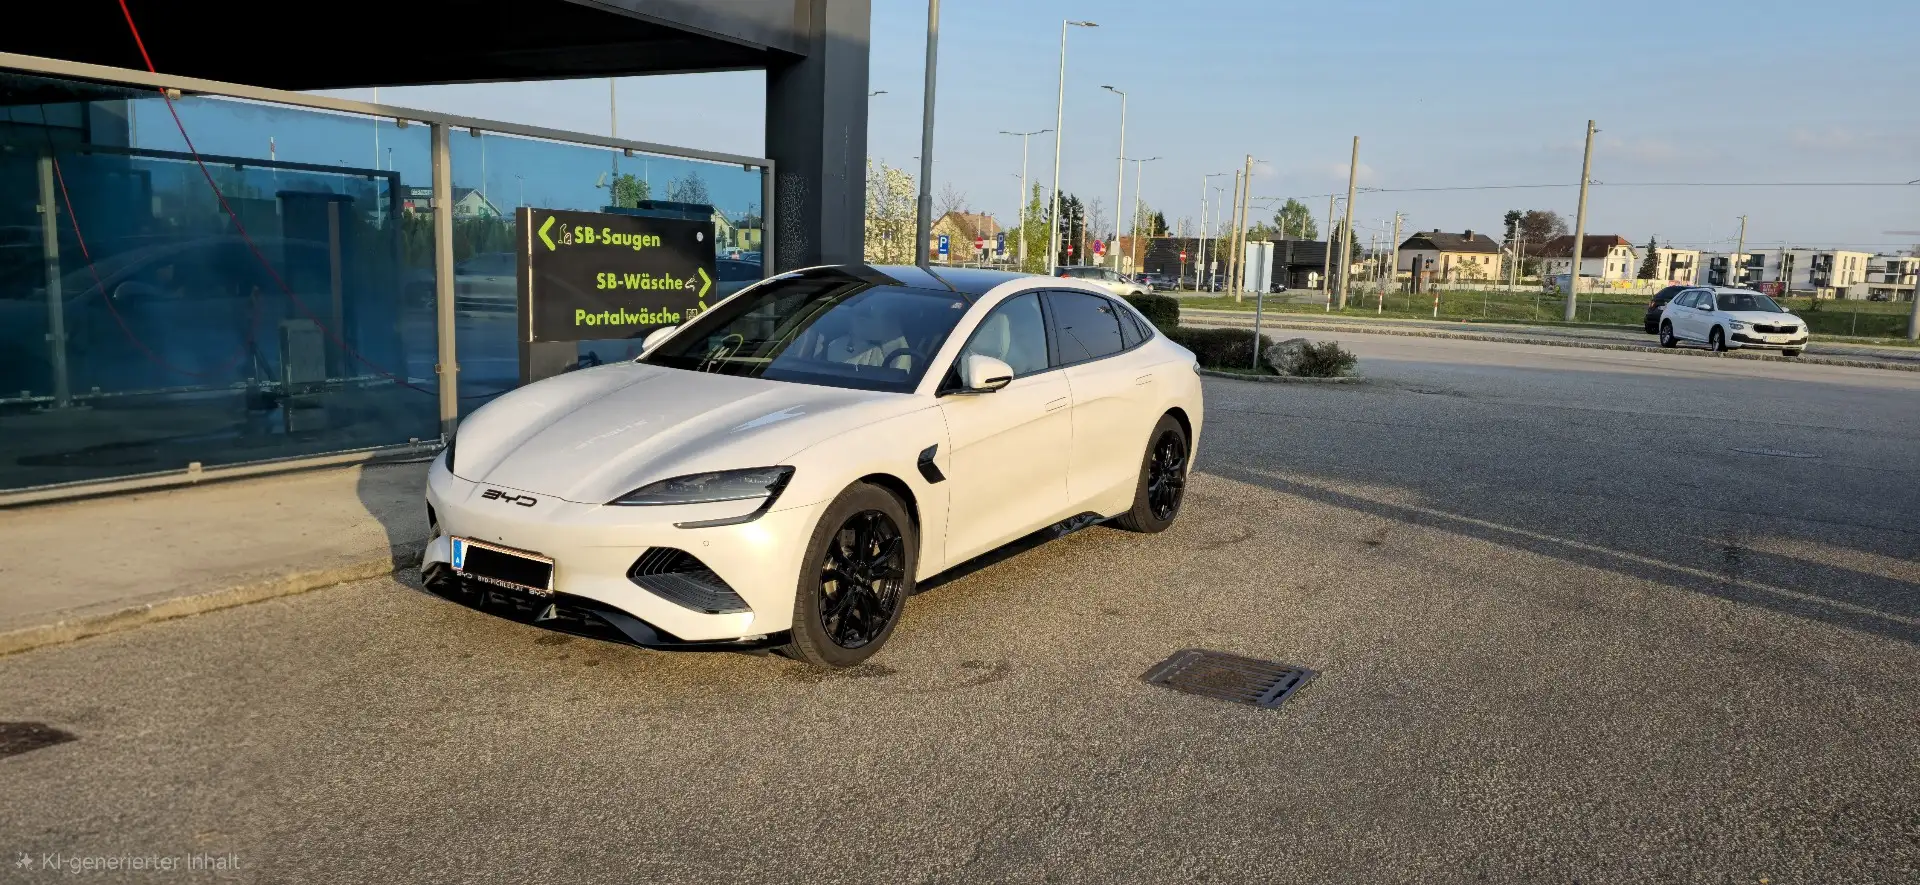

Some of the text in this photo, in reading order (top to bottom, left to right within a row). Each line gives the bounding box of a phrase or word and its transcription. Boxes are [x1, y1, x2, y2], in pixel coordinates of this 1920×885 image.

[574, 226, 661, 250] SB-Saugen
[940, 236, 947, 248] P
[596, 272, 683, 290] SB-Wäsche
[575, 307, 681, 326] Portalwäsche
[481, 488, 538, 508] BYD
